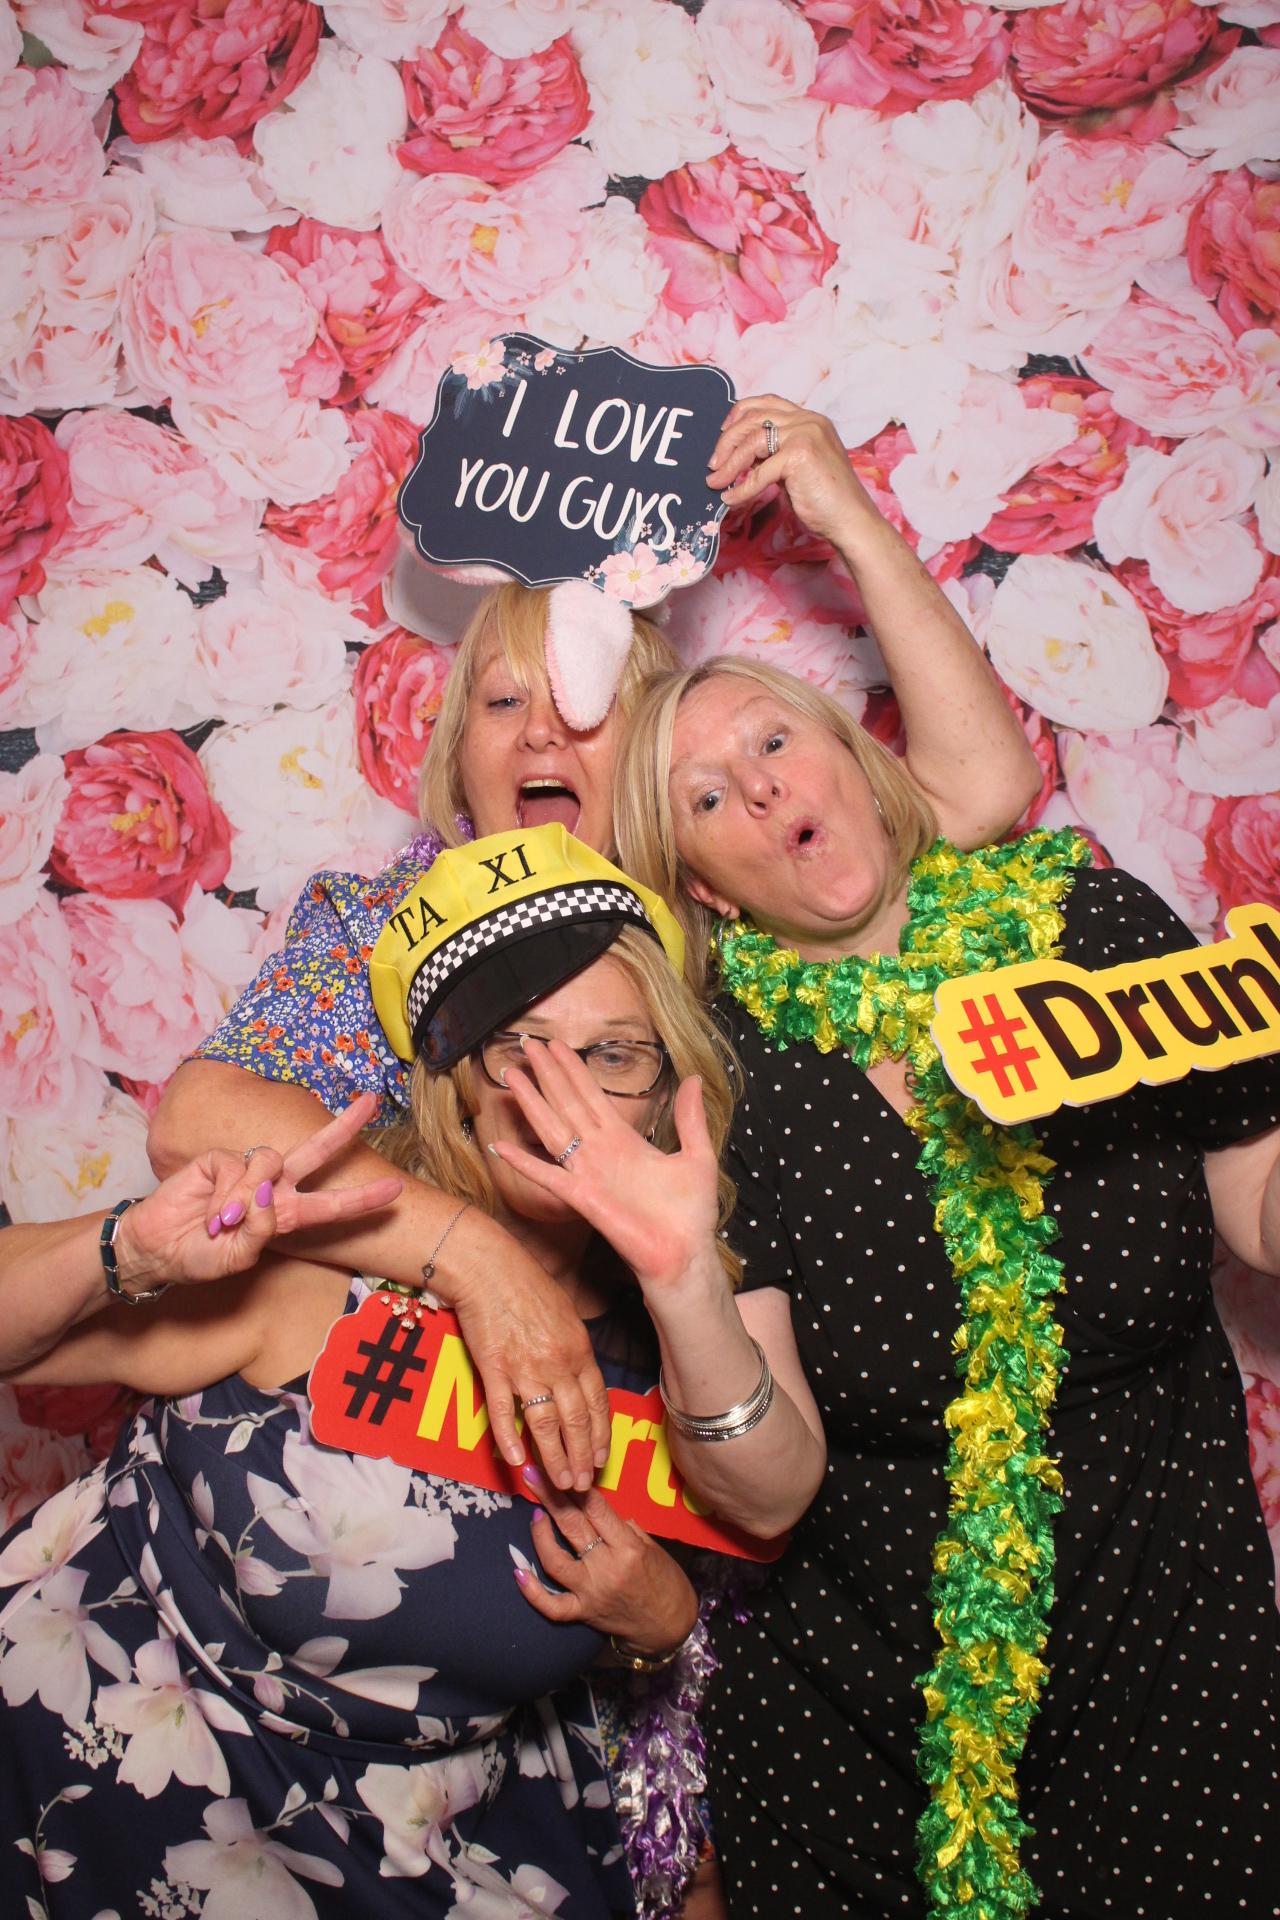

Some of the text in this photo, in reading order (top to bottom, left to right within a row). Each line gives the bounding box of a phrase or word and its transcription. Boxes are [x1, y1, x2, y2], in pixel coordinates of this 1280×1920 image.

[502, 379, 694, 466] I LOVE
[454, 457, 682, 551] YOU GUYS
